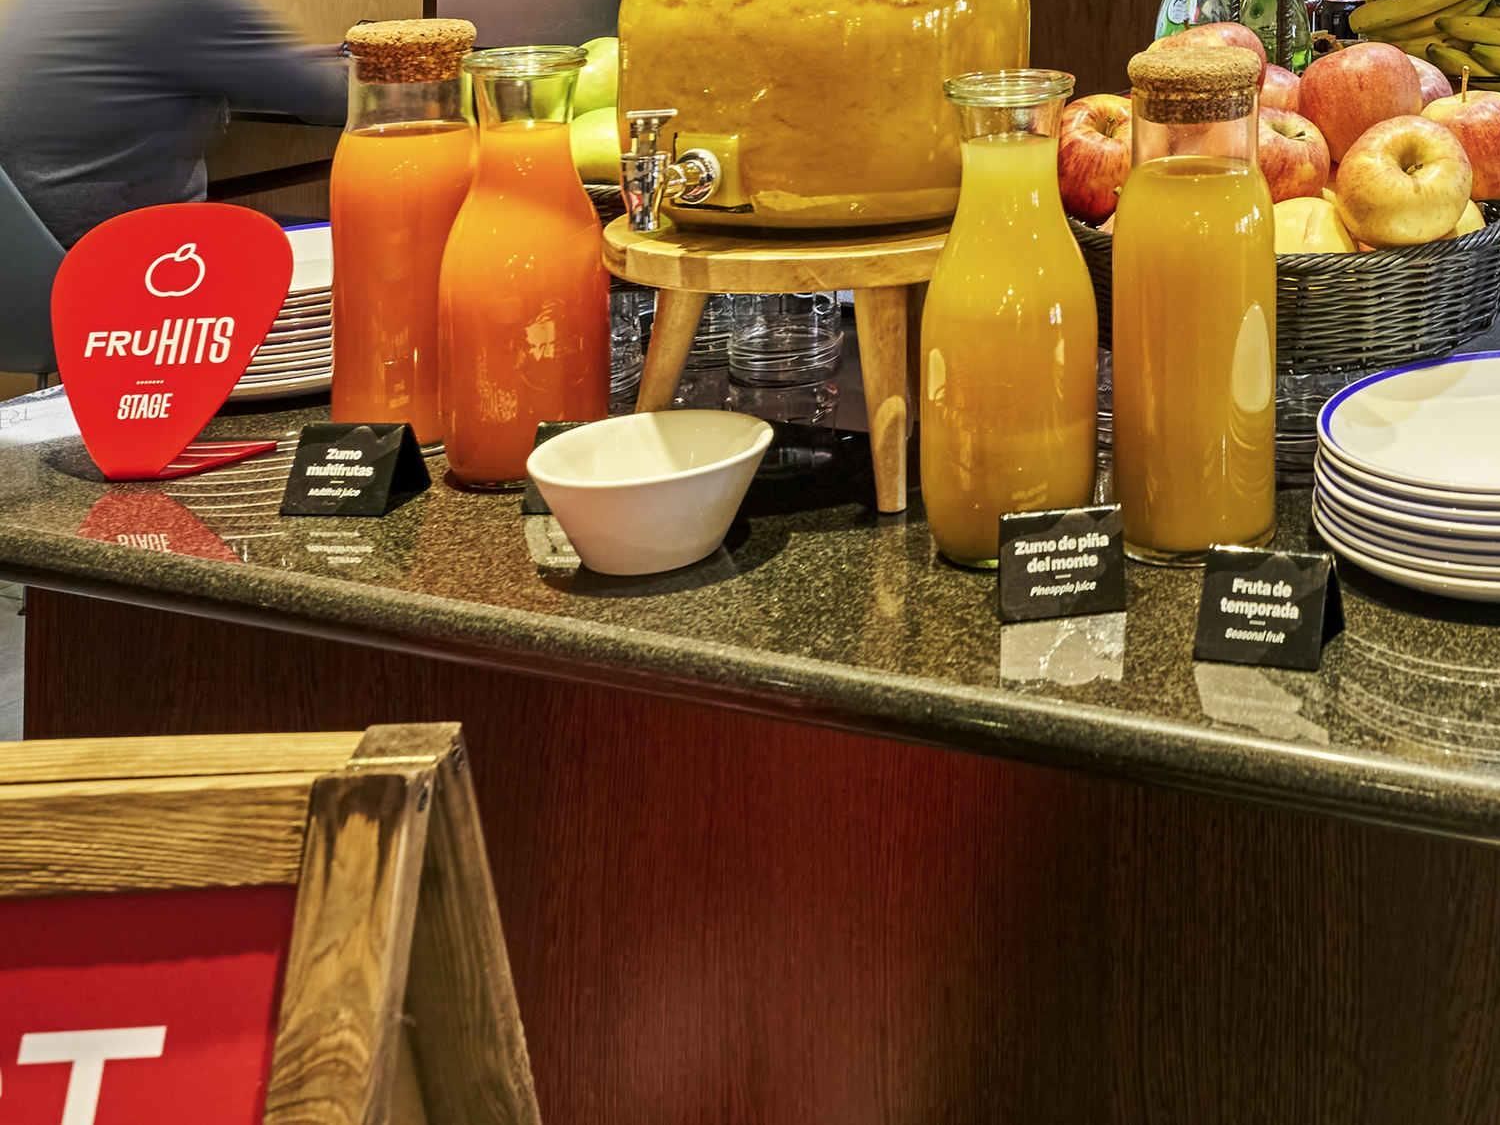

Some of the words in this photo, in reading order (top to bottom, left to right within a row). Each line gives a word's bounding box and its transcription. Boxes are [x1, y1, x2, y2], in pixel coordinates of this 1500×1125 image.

[84, 317, 235, 365] FRUHITS
[117, 393, 173, 420] STAGE
[325, 448, 363, 460] Zumo
[306, 463, 374, 477] multifrutas
[1014, 540, 1056, 555] Zumo
[1057, 535, 1077, 551] de
[1078, 533, 1109, 553] piña
[1026, 556, 1051, 573] del
[1051, 554, 1098, 571] monte
[1029, 581, 1075, 597] Pineapple
[1073, 579, 1097, 594] juice
[1232, 577, 1272, 596] Fruta
[1272, 579, 1292, 598] de
[1220, 597, 1299, 619] temporada
[1225, 627, 1267, 642] Seasonal
[1265, 630, 1285, 644] fruit
